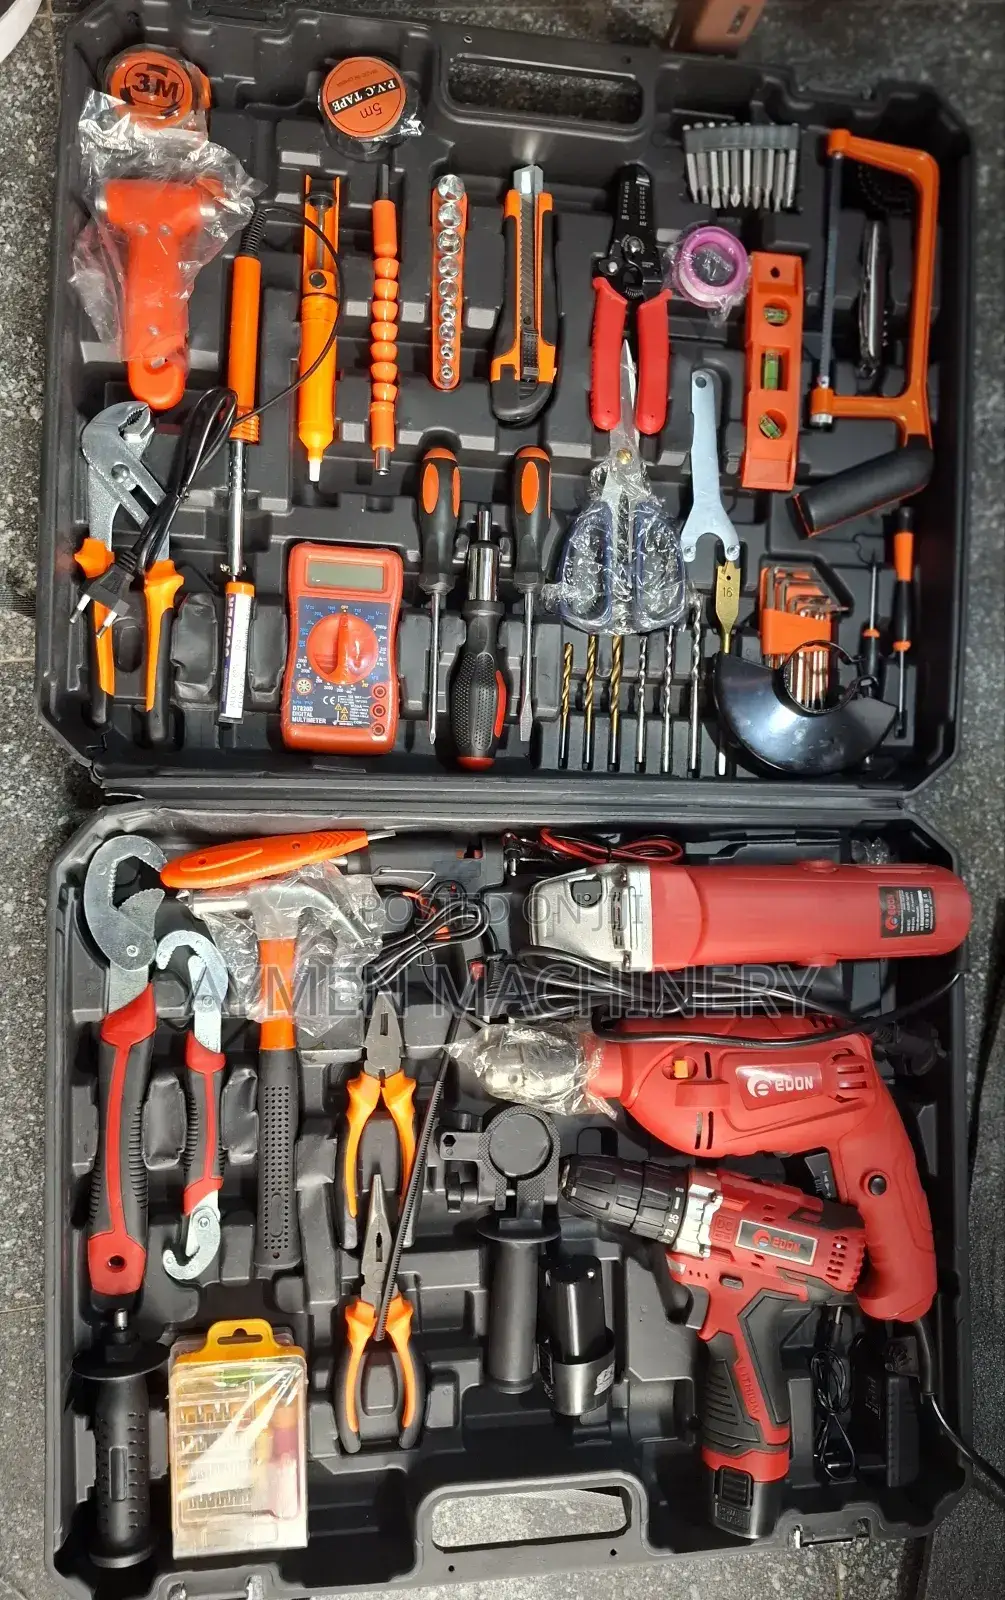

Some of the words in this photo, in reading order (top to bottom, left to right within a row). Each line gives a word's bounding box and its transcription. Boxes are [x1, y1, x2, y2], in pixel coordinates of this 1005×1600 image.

[365, 79, 396, 96] P.V.C
[332, 91, 363, 112] TAPE
[360, 102, 383, 119] 5m
[723, 587, 733, 598] 16
[668, 1213, 680, 1224] 25
[737, 1365, 761, 1414] LITHIUM
